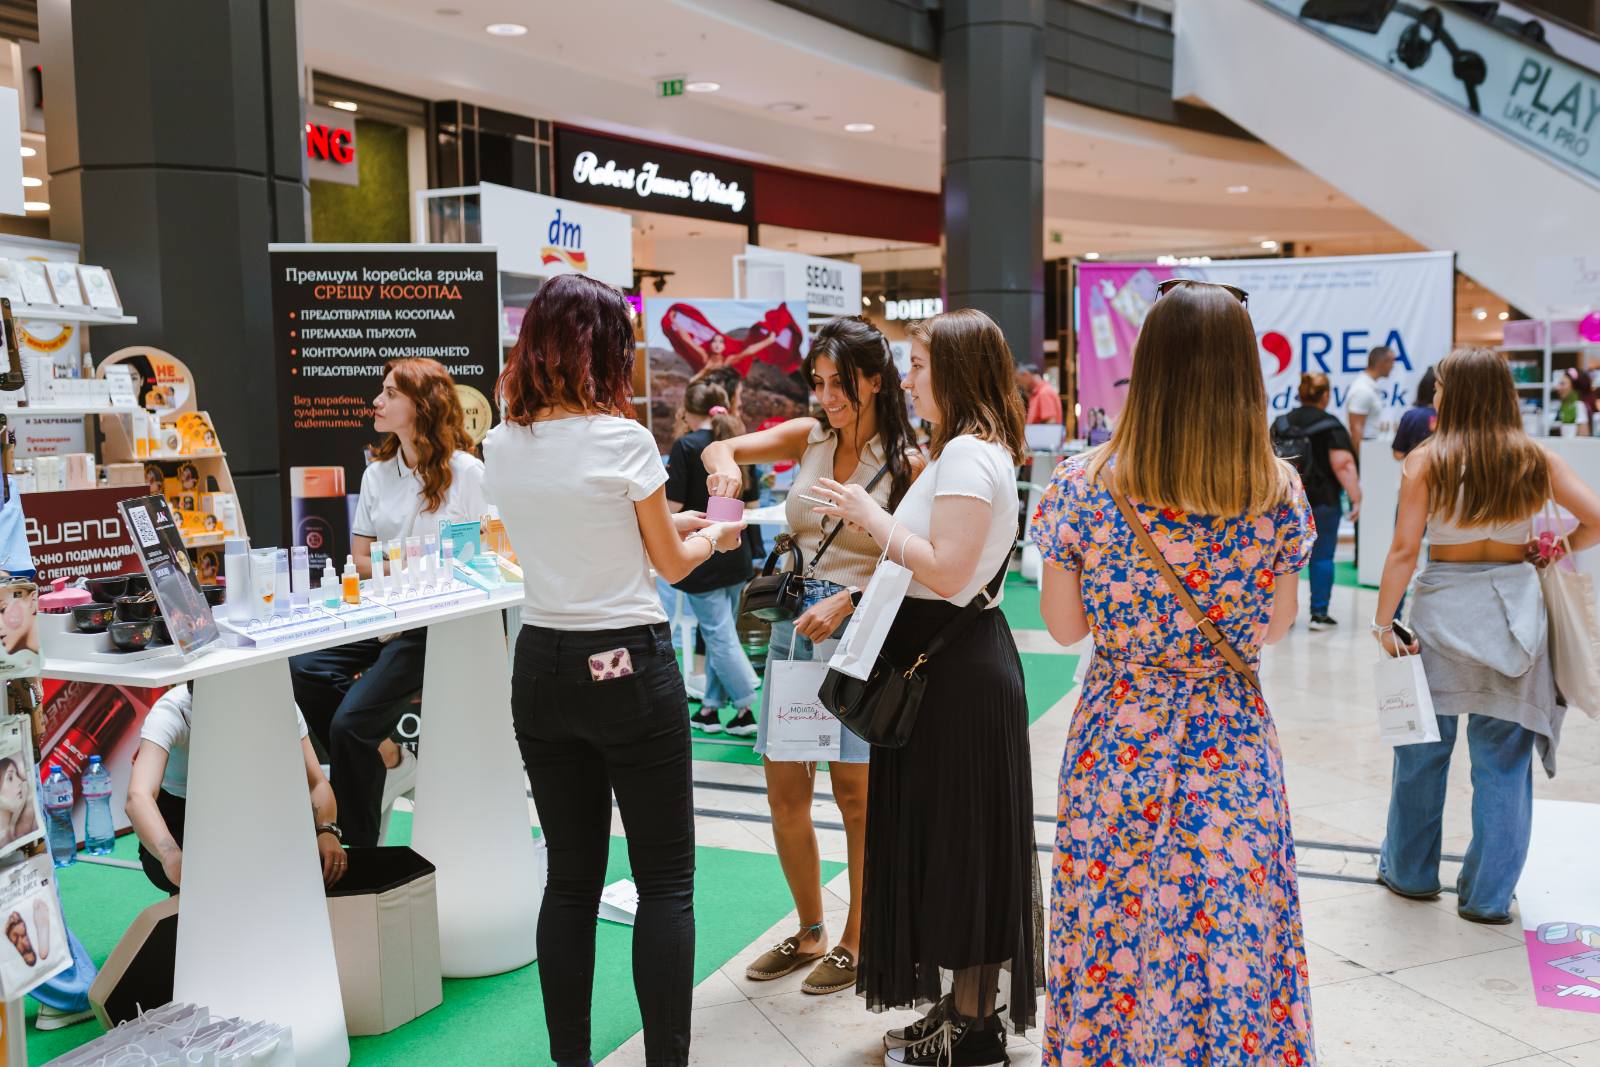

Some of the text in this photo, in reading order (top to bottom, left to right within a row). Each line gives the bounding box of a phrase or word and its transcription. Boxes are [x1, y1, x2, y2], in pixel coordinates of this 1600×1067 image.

[1503, 101, 1590, 158] LIKE A PRO
[305, 122, 355, 164] NG
[573, 151, 635, 190] Robert
[636, 162, 691, 197] James
[548, 208, 581, 249] dm
[286, 267, 483, 284] Премиум корейска грижа
[806, 265, 844, 291] SEOUL
[314, 285, 462, 301] СРЕЩУ КОСОПАД
[301, 309, 455, 321] ПРЕДОТВРАТЯВА КОСОПАДА
[301, 328, 416, 339] ПРЕМАХВА ПЪРХОТА
[302, 346, 469, 358] КОНТРОЛИРА ОМАЗНЯВАНЕТО
[445, 365, 484, 376] АНЕТО
[294, 395, 311, 406] Без
[294, 407, 376, 418] сулфати и изку
[31, 552, 64, 566] ЪЧНО
[66, 544, 139, 562] ПОДМЛАДЯВА
[38, 560, 123, 580] С ПЕПТИДИ И MGF
